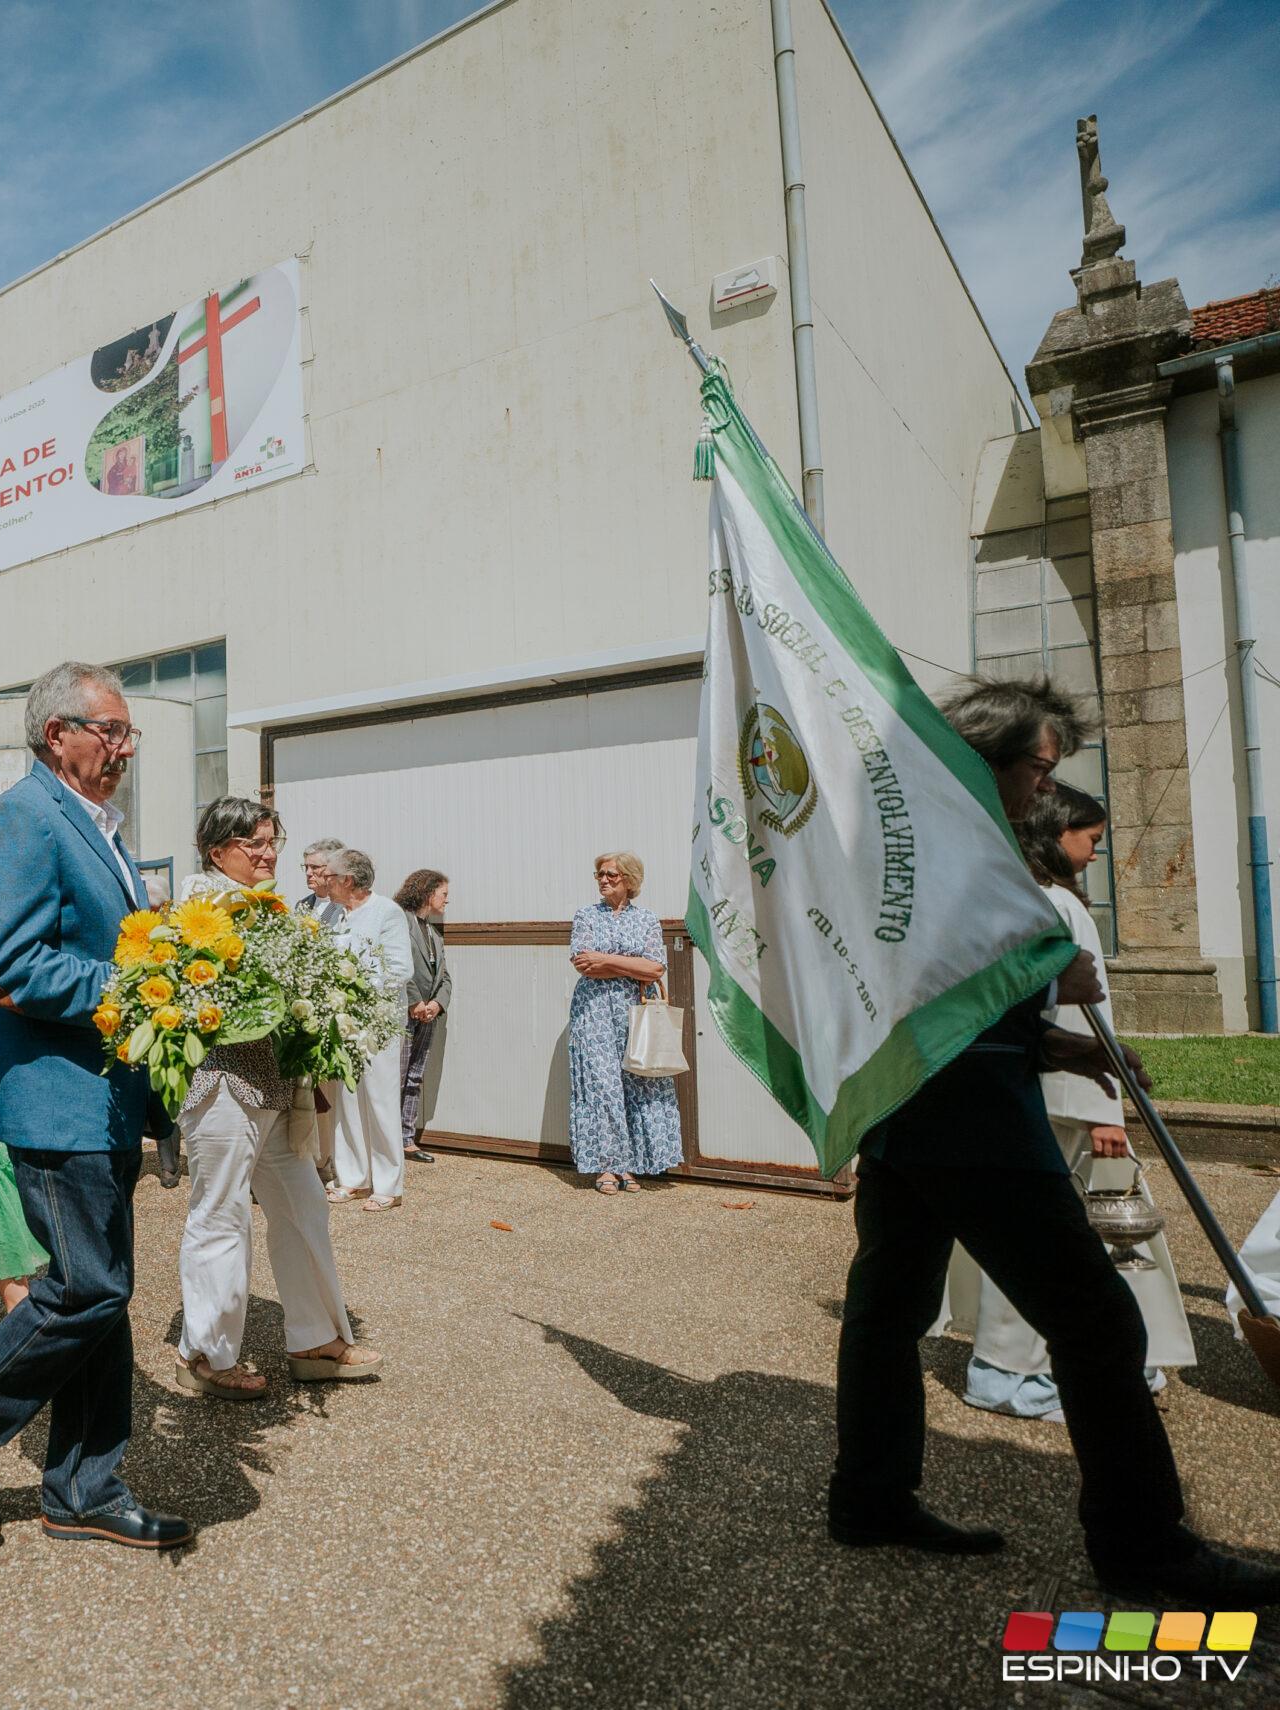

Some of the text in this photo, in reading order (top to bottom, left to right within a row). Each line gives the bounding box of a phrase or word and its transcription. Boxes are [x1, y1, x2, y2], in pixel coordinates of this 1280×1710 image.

[23, 437, 56, 467] DE
[234, 466, 263, 480] ANTA
[757, 603, 828, 674] SOCIAL
[840, 705, 916, 943] DESENVOLVIMENTO
